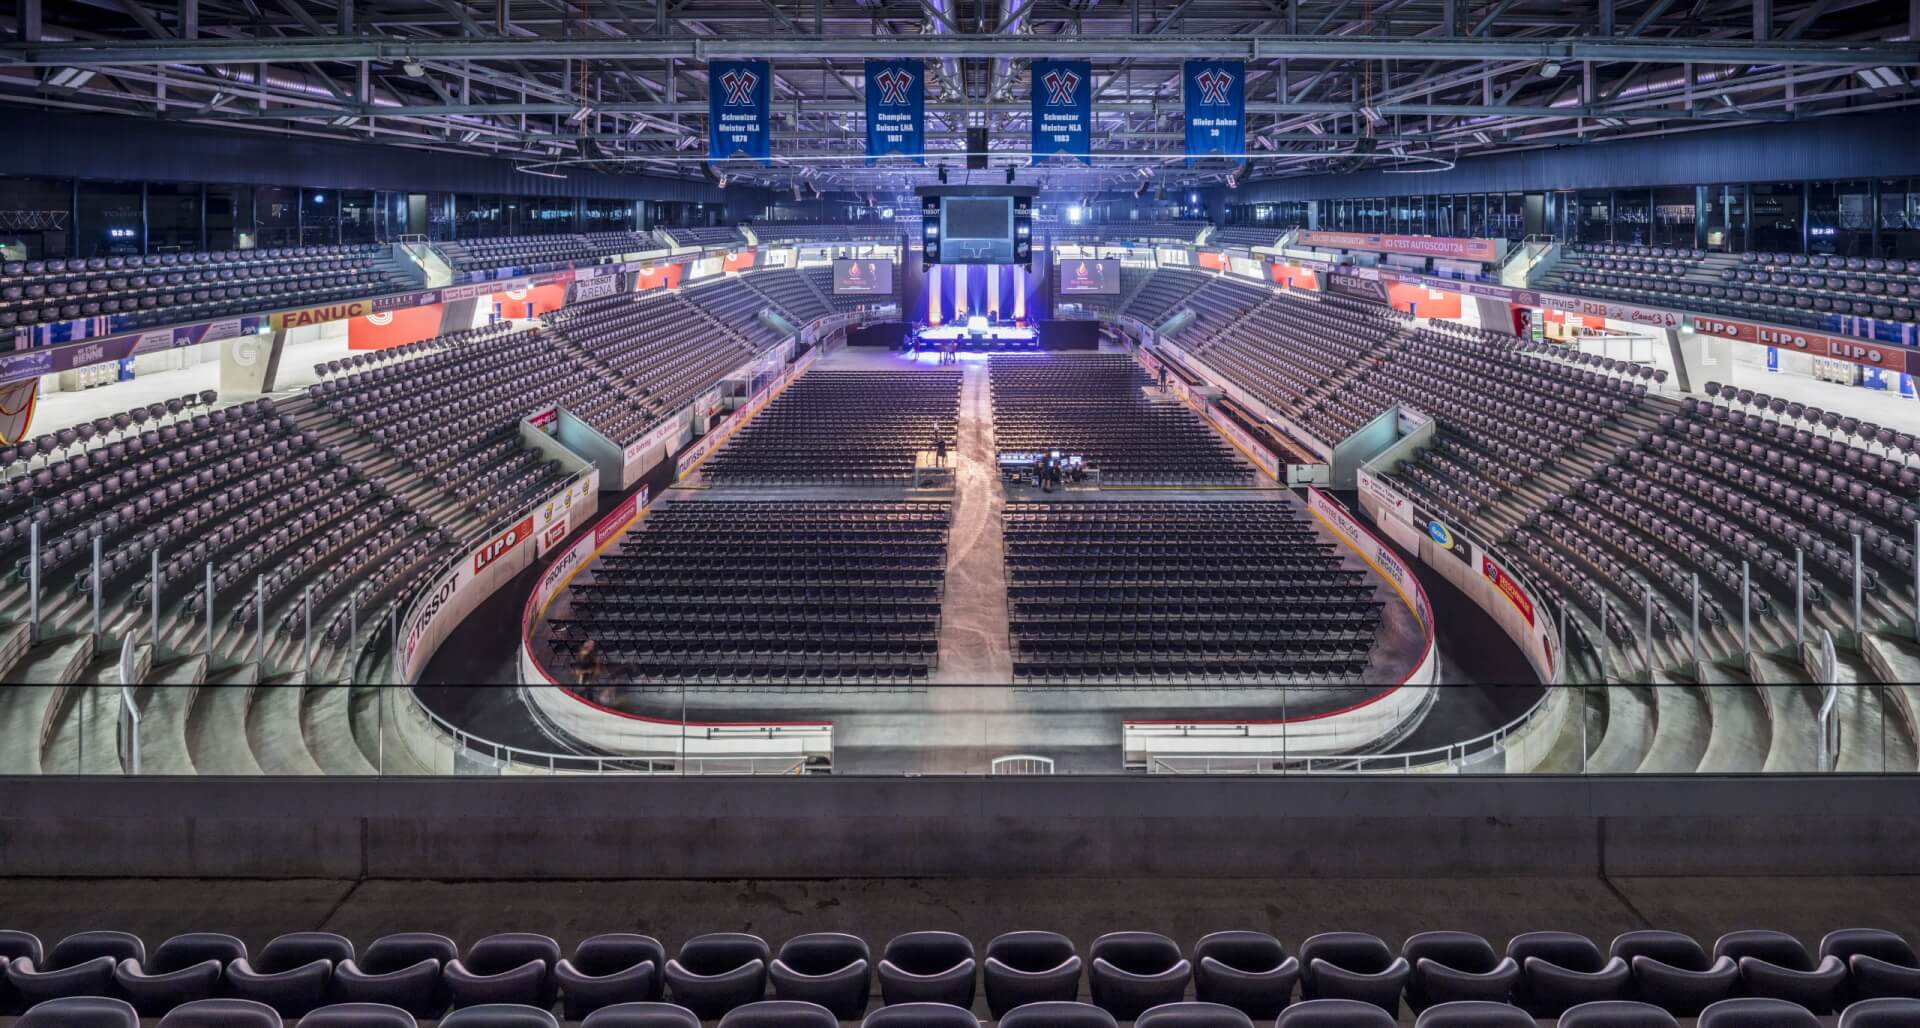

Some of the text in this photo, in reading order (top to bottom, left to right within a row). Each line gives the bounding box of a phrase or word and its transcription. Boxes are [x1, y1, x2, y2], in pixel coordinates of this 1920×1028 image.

[721, 113, 757, 121] Schweizer
[878, 113, 911, 122] Champion
[1043, 113, 1079, 121] Schweizer
[876, 123, 899, 131] Suisse
[1040, 123, 1068, 131] Meister
[1410, 240, 1463, 252] AUTOSCOUT24
[582, 285, 612, 297] ARENA
[1583, 302, 1607, 316] RJB
[282, 303, 363, 328] FANUC
[242, 326, 257, 335] AXA
[1694, 319, 1739, 336] LIPO
[175, 337, 192, 345] AXA
[1760, 330, 1808, 348] LIPO
[1831, 342, 1884, 362] LIPO
[476, 531, 516, 569] LIPO
[545, 548, 577, 590] PROFFIX
[415, 572, 460, 640] TISSOT
